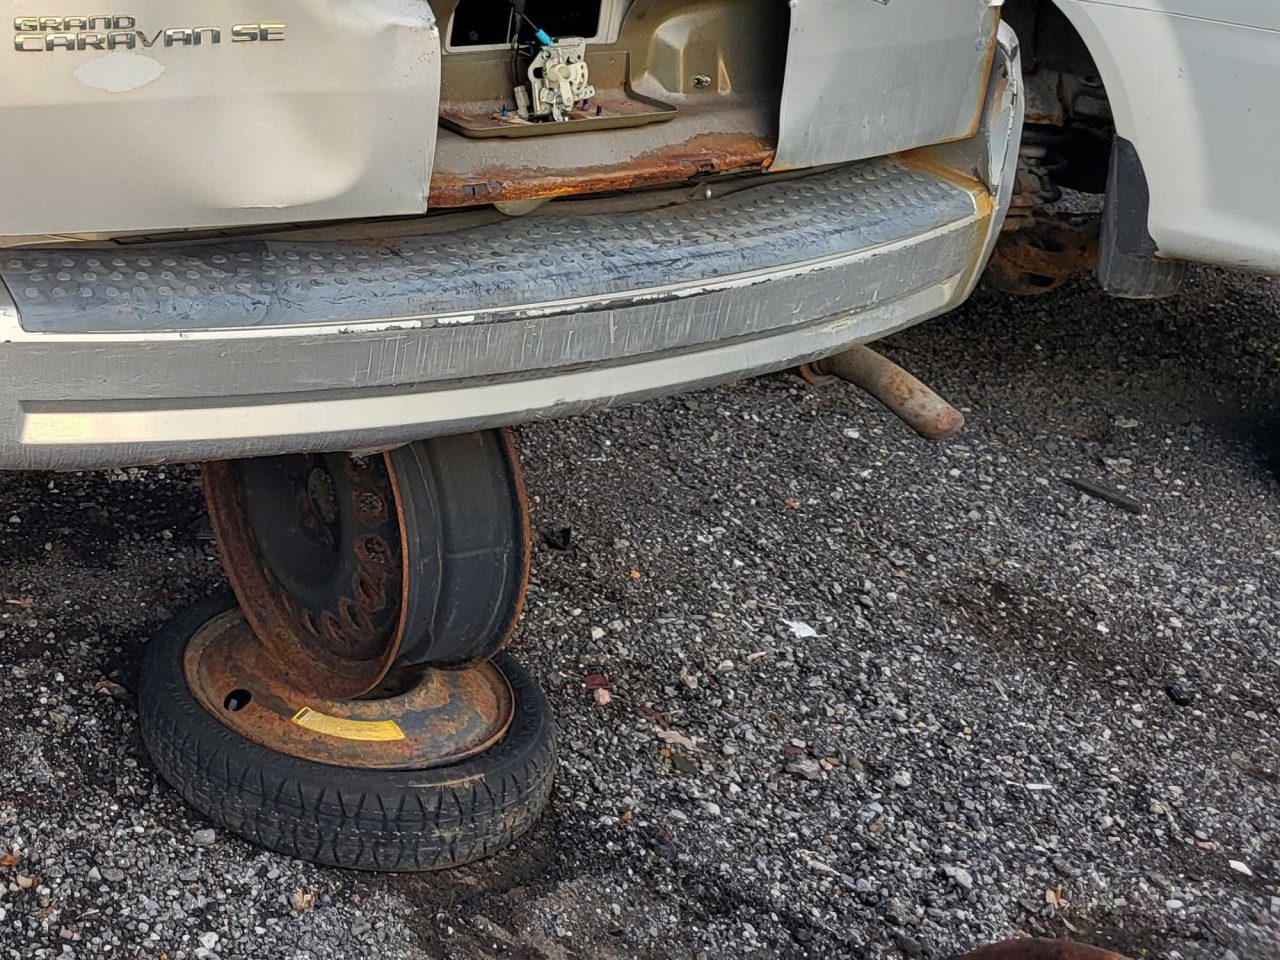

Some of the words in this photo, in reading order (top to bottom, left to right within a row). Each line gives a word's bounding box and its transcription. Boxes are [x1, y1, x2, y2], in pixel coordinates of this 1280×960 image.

[13, 15, 136, 32] GRAND
[13, 27, 222, 52] CARAVAN
[231, 23, 287, 43] SE
